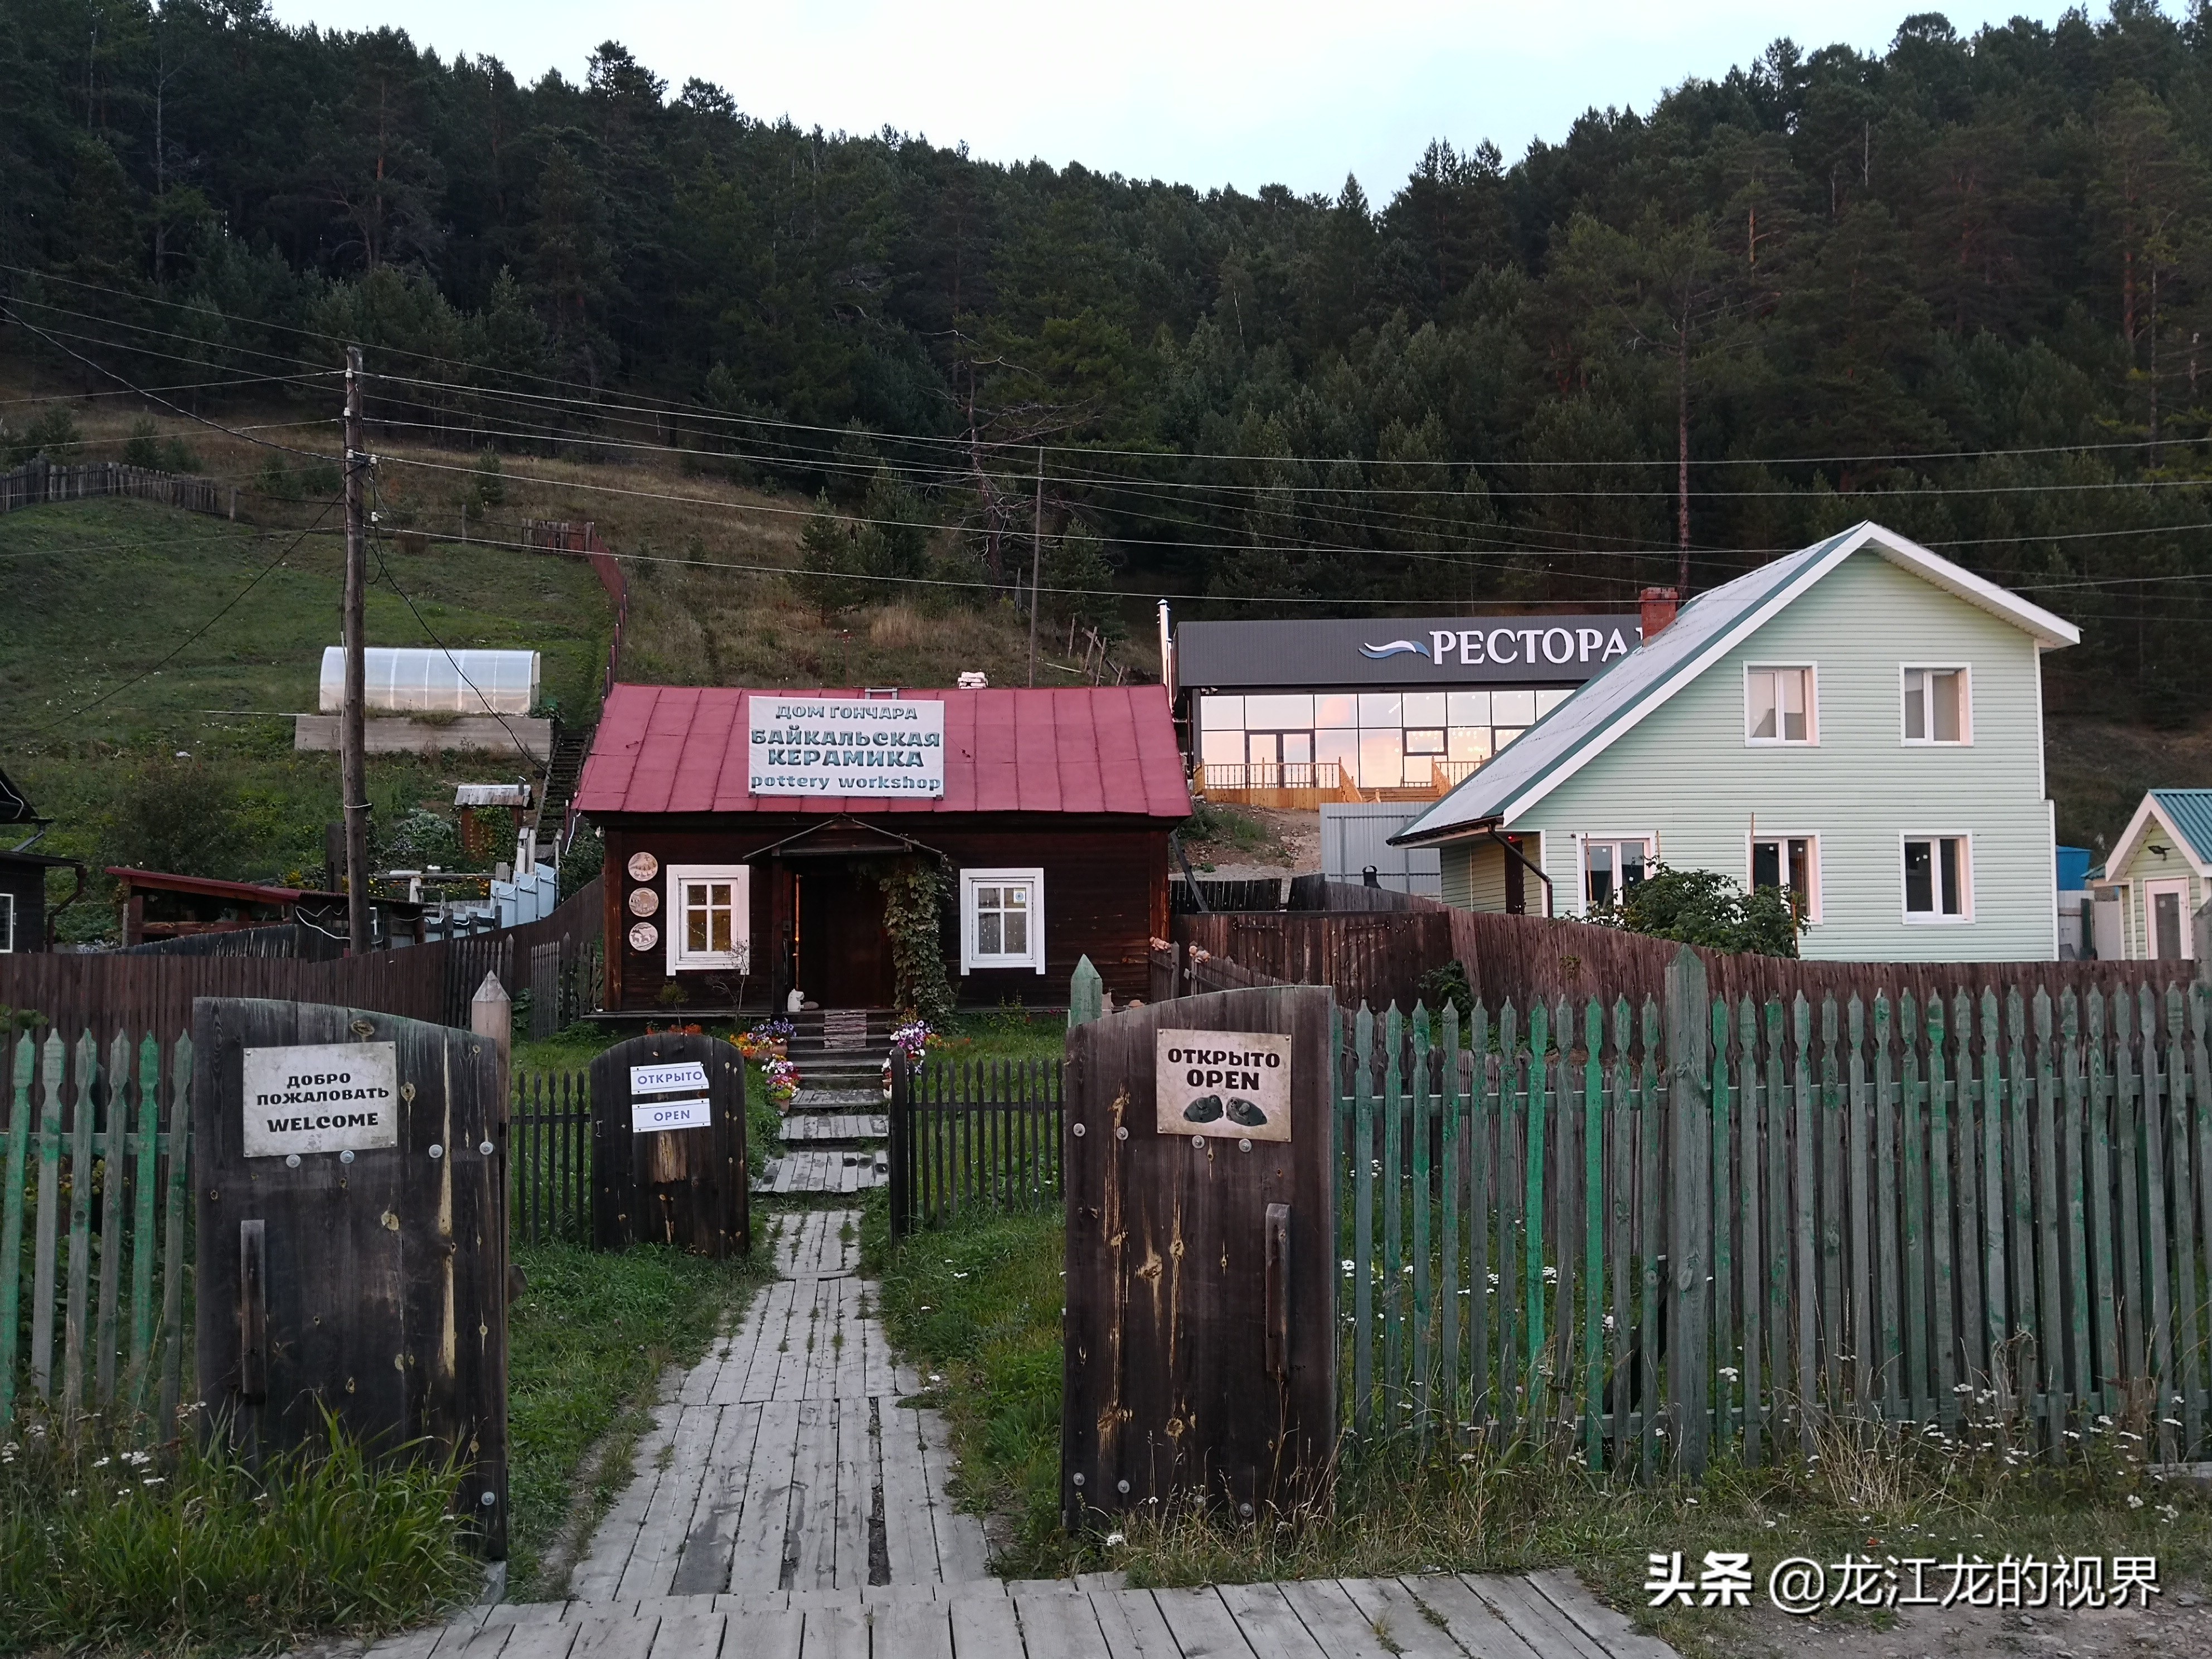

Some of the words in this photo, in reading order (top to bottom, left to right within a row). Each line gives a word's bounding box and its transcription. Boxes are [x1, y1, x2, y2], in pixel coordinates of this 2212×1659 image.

[1429, 627, 1643, 664] РЕСТОРА
[775, 705, 824, 720] ДОМ
[830, 705, 918, 720] ГОНЧАРА
[751, 725, 940, 747] БАЙКАЛЬСКАЯ
[768, 748, 924, 767] КЕРАМИКА
[751, 775, 830, 790] pottery
[838, 775, 941, 791] workshop
[1168, 1048, 1280, 1068] ОТКРЫТО
[287, 1073, 351, 1089] ДОБРО
[637, 1071, 702, 1085] ОТКРЫТО
[1187, 1069, 1259, 1090] OPEN
[257, 1088, 389, 1105] ПОЖАЛОВАТЬ
[266, 1113, 379, 1133] WELCOME
[654, 1110, 690, 1122] OPEN
